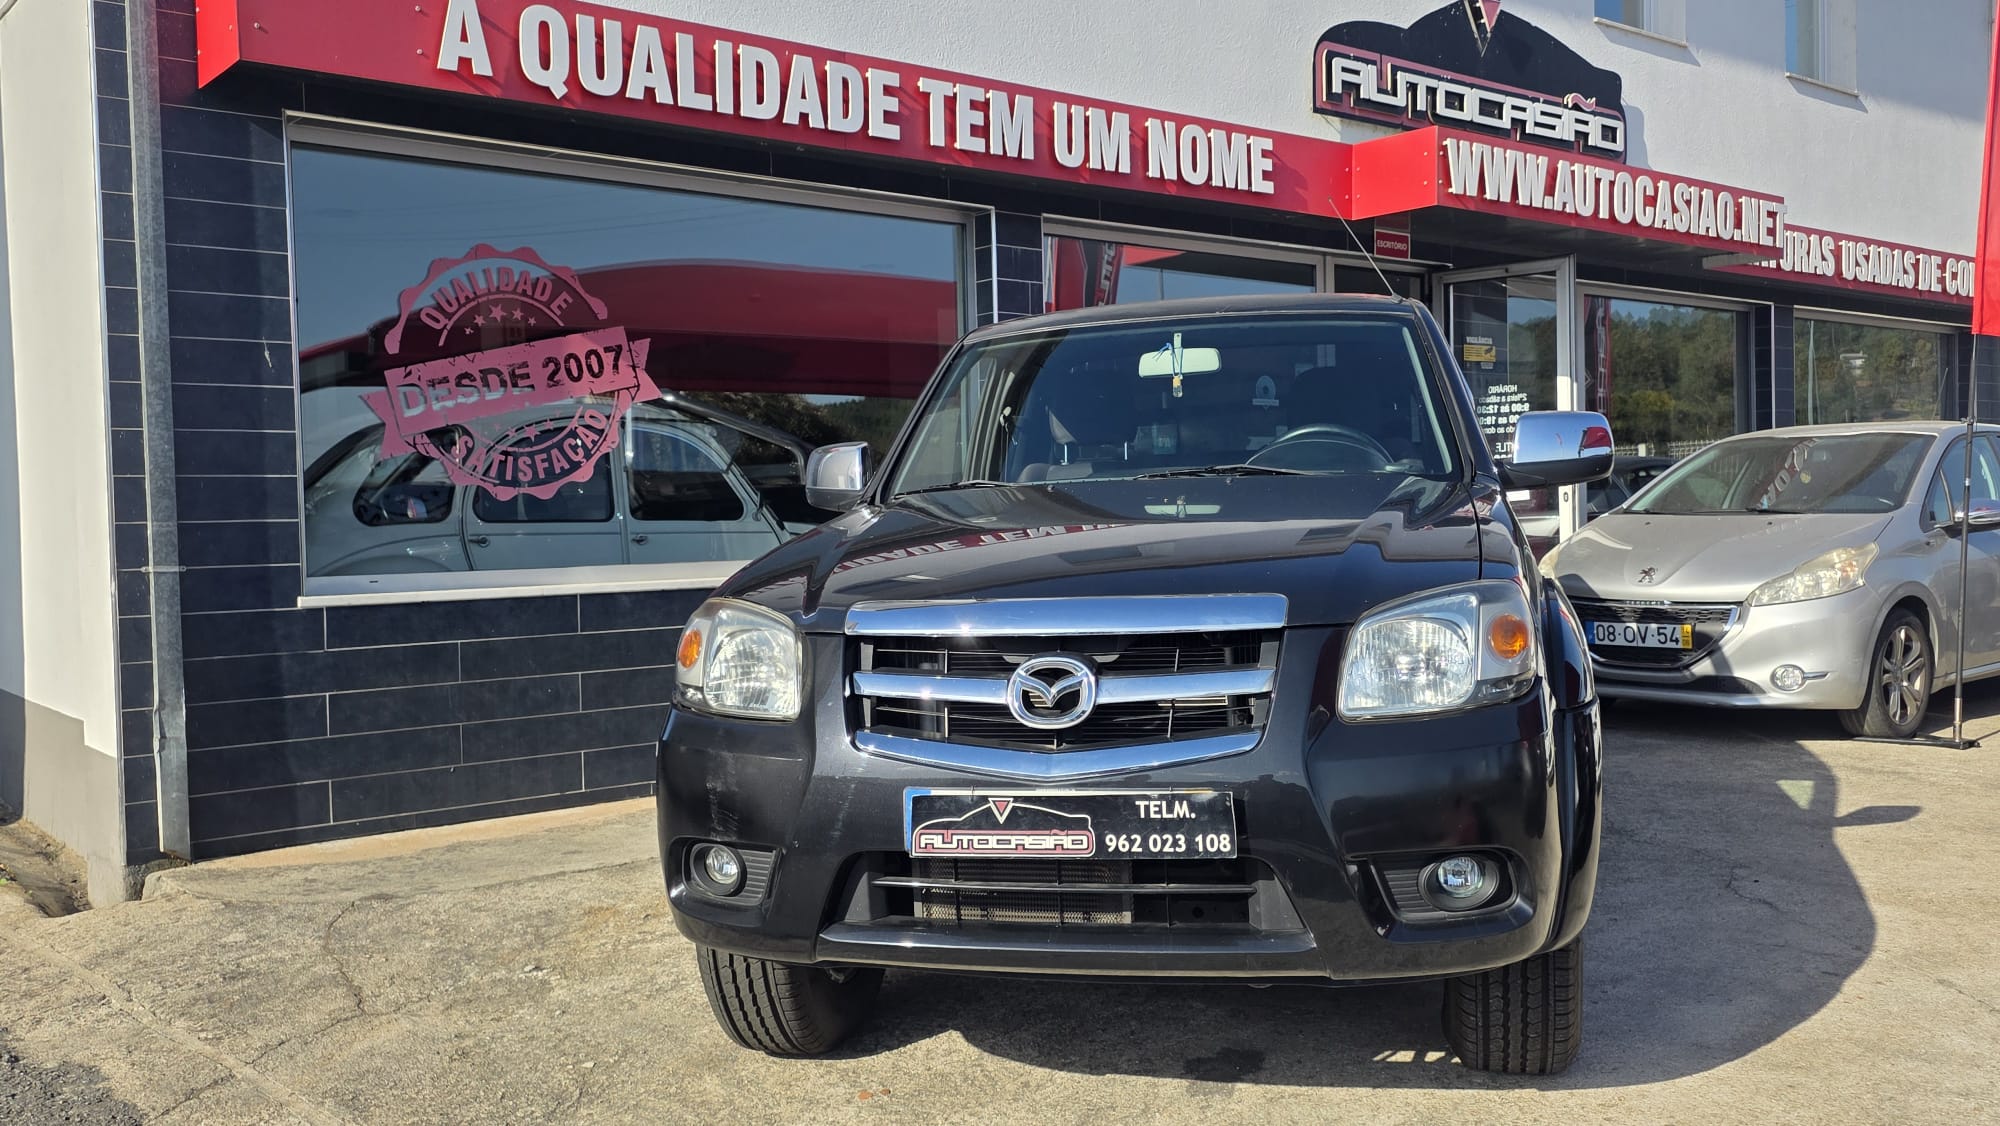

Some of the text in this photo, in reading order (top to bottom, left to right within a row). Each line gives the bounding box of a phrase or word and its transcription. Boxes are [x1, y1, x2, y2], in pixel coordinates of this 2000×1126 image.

[437, 0, 1274, 194] A QUALIDADE TEM UM NOME
[1330, 54, 1625, 152] AUTOCASIÃO
[1444, 138, 1788, 248] WWW.AUTOCASIAO.NET
[1750, 230, 1836, 277] URAS
[1839, 239, 1915, 289] USADAS
[1917, 253, 1942, 292] DE
[420, 266, 573, 331] QUALIDADE
[402, 344, 624, 417] DESDE 2007
[1105, 833, 1142, 853] 962
[1148, 833, 1186, 853] 023
[1194, 833, 1232, 853] 108
[1135, 800, 1195, 819] TELM.
